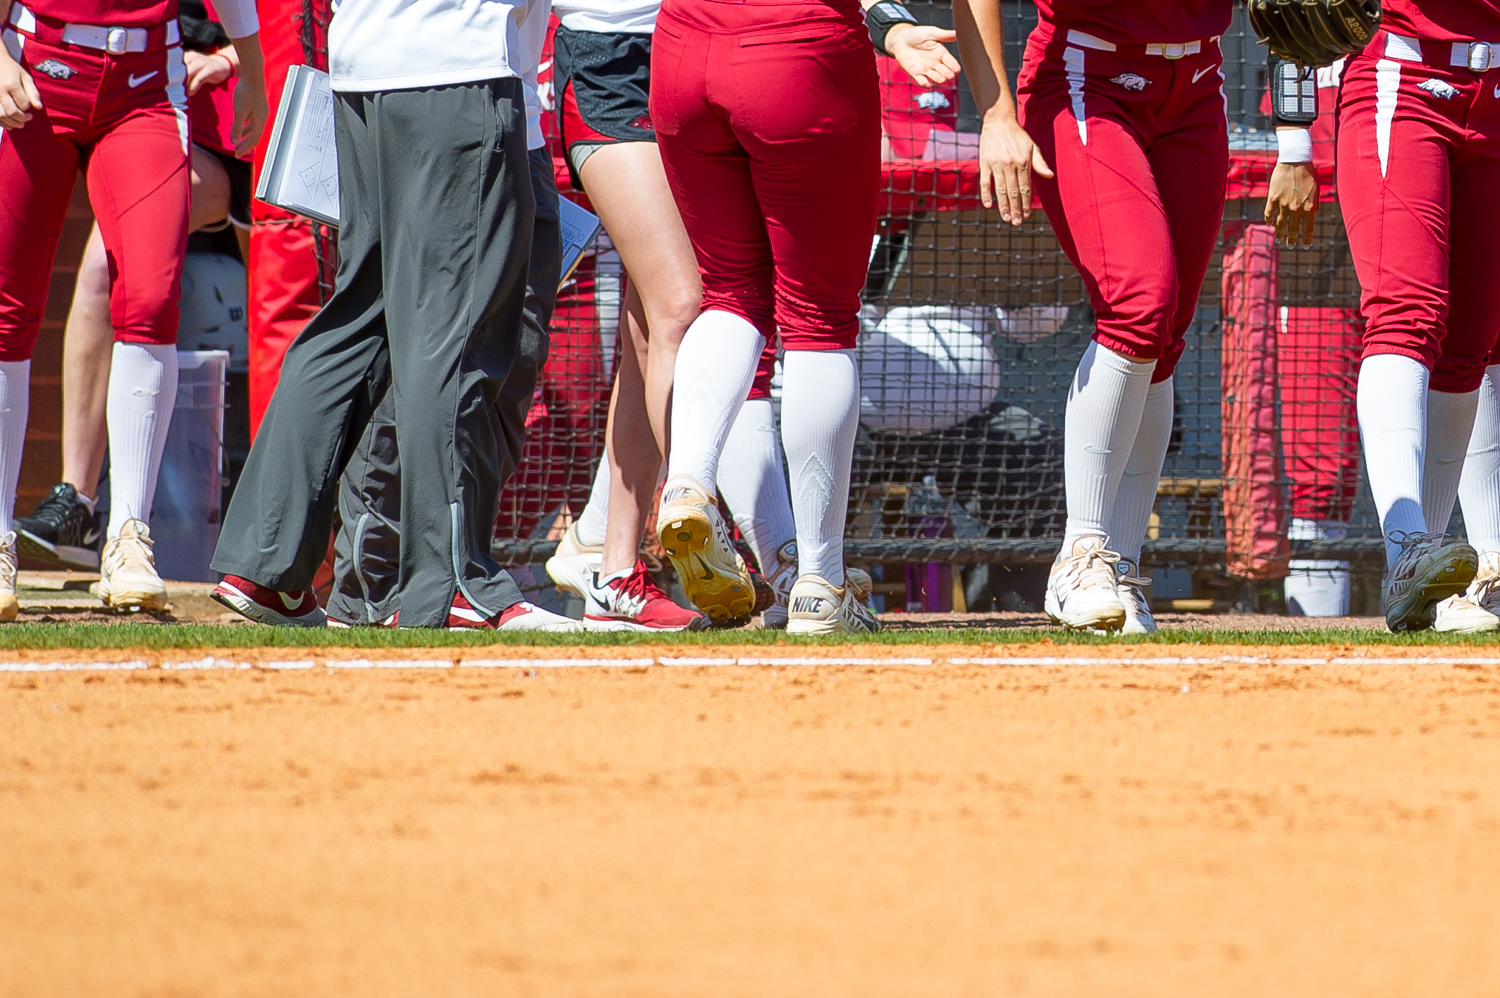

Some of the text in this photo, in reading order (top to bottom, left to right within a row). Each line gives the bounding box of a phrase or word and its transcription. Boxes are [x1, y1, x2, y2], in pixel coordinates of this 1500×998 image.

[1344, 16, 1368, 41] A2000
[660, 486, 692, 509] NIKE
[792, 596, 824, 614] NIKE
